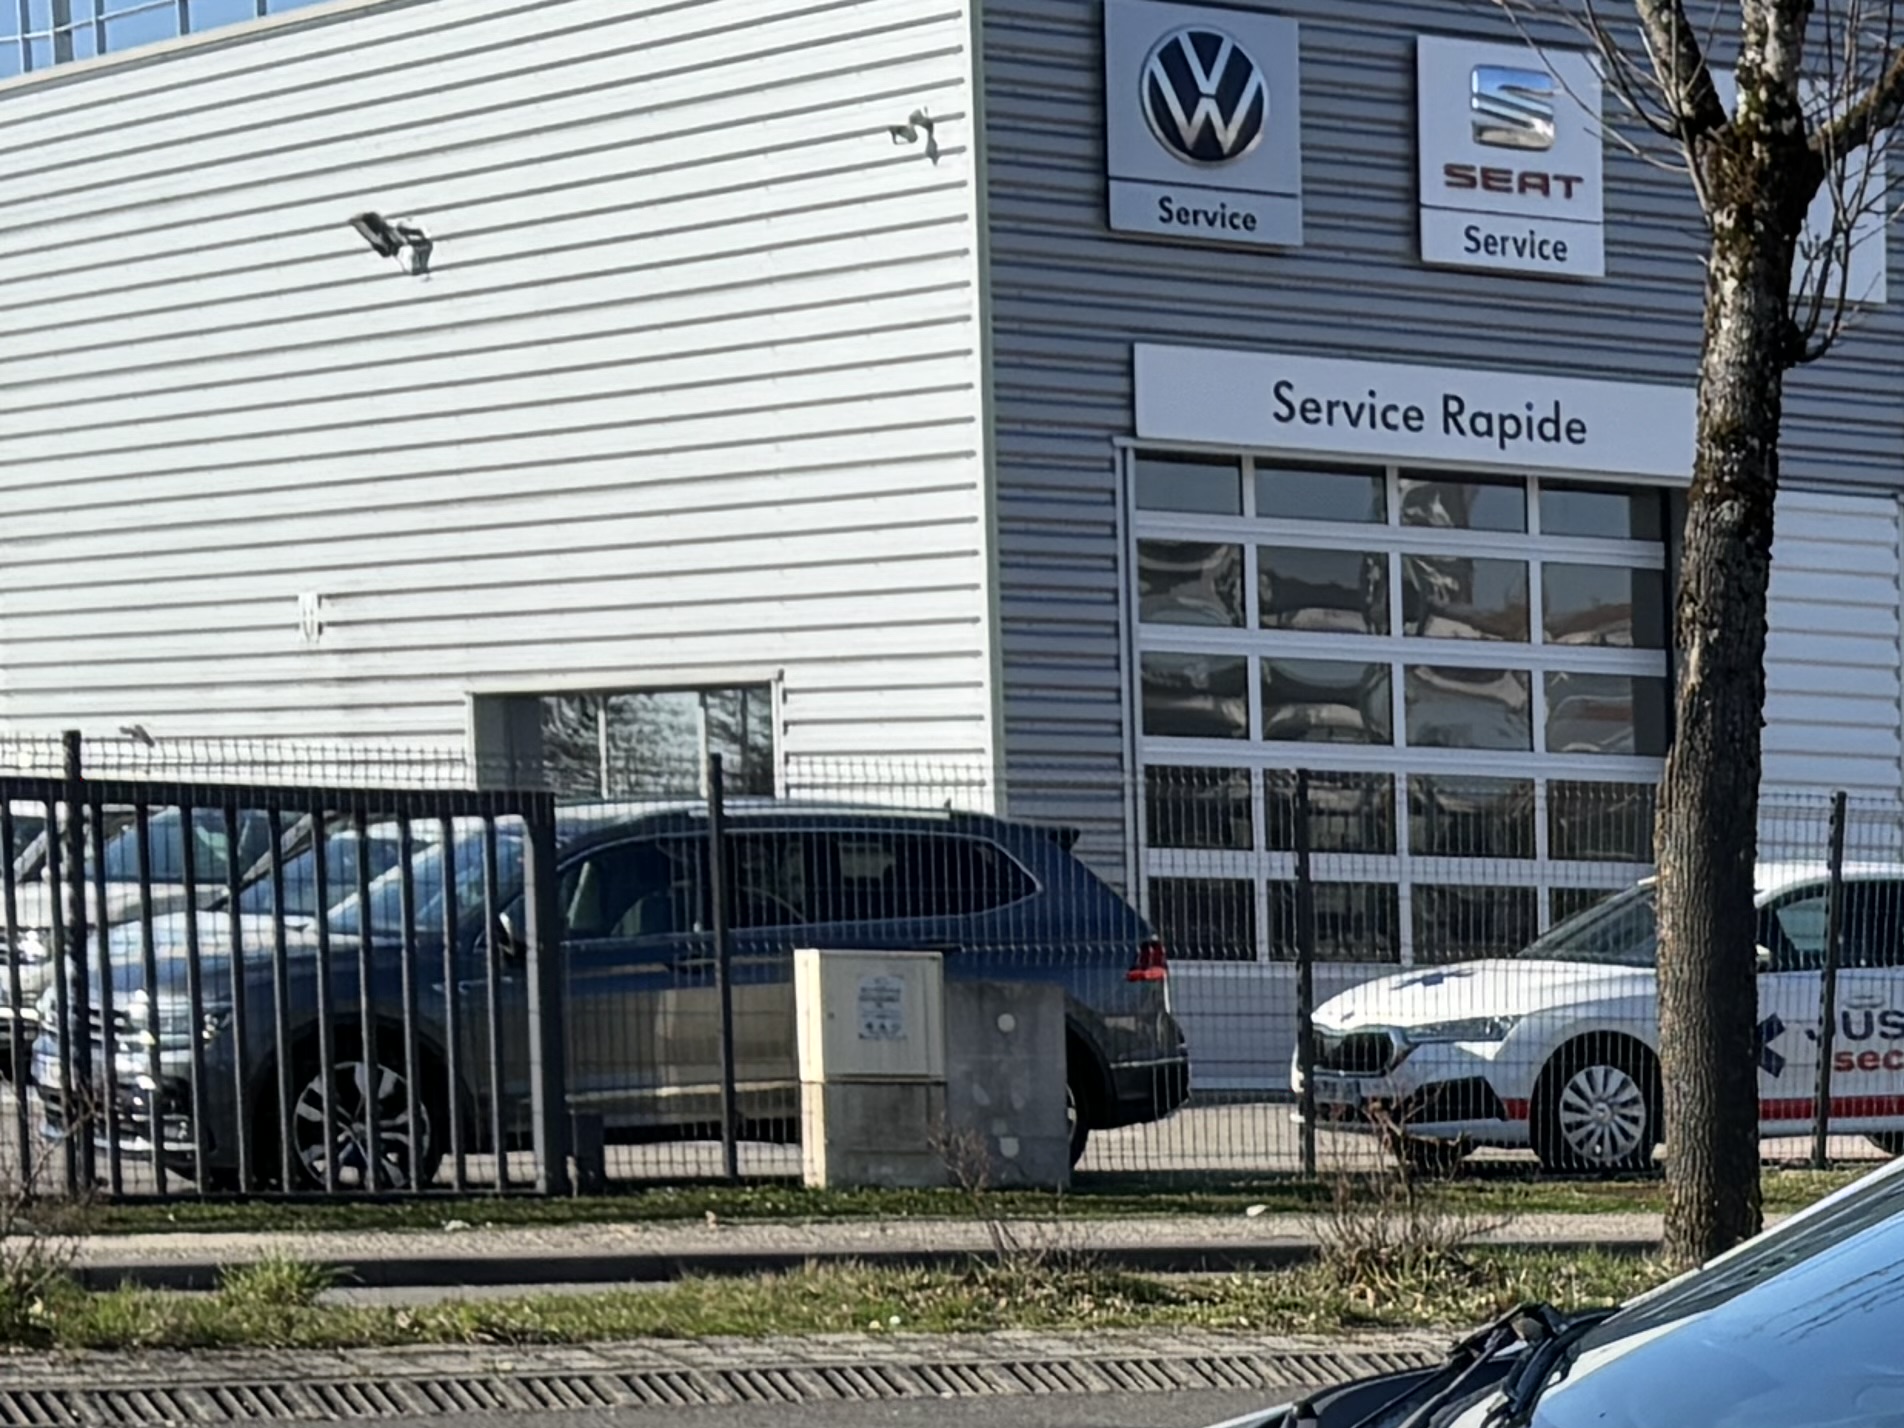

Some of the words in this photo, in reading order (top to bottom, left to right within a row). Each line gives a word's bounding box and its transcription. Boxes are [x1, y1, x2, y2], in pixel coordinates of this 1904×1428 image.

[1443, 162, 1584, 200] SEAT
[1158, 195, 1257, 232] Service
[1463, 224, 1568, 263] Service
[1272, 379, 1425, 433] Service
[1442, 393, 1588, 451] Rapide
